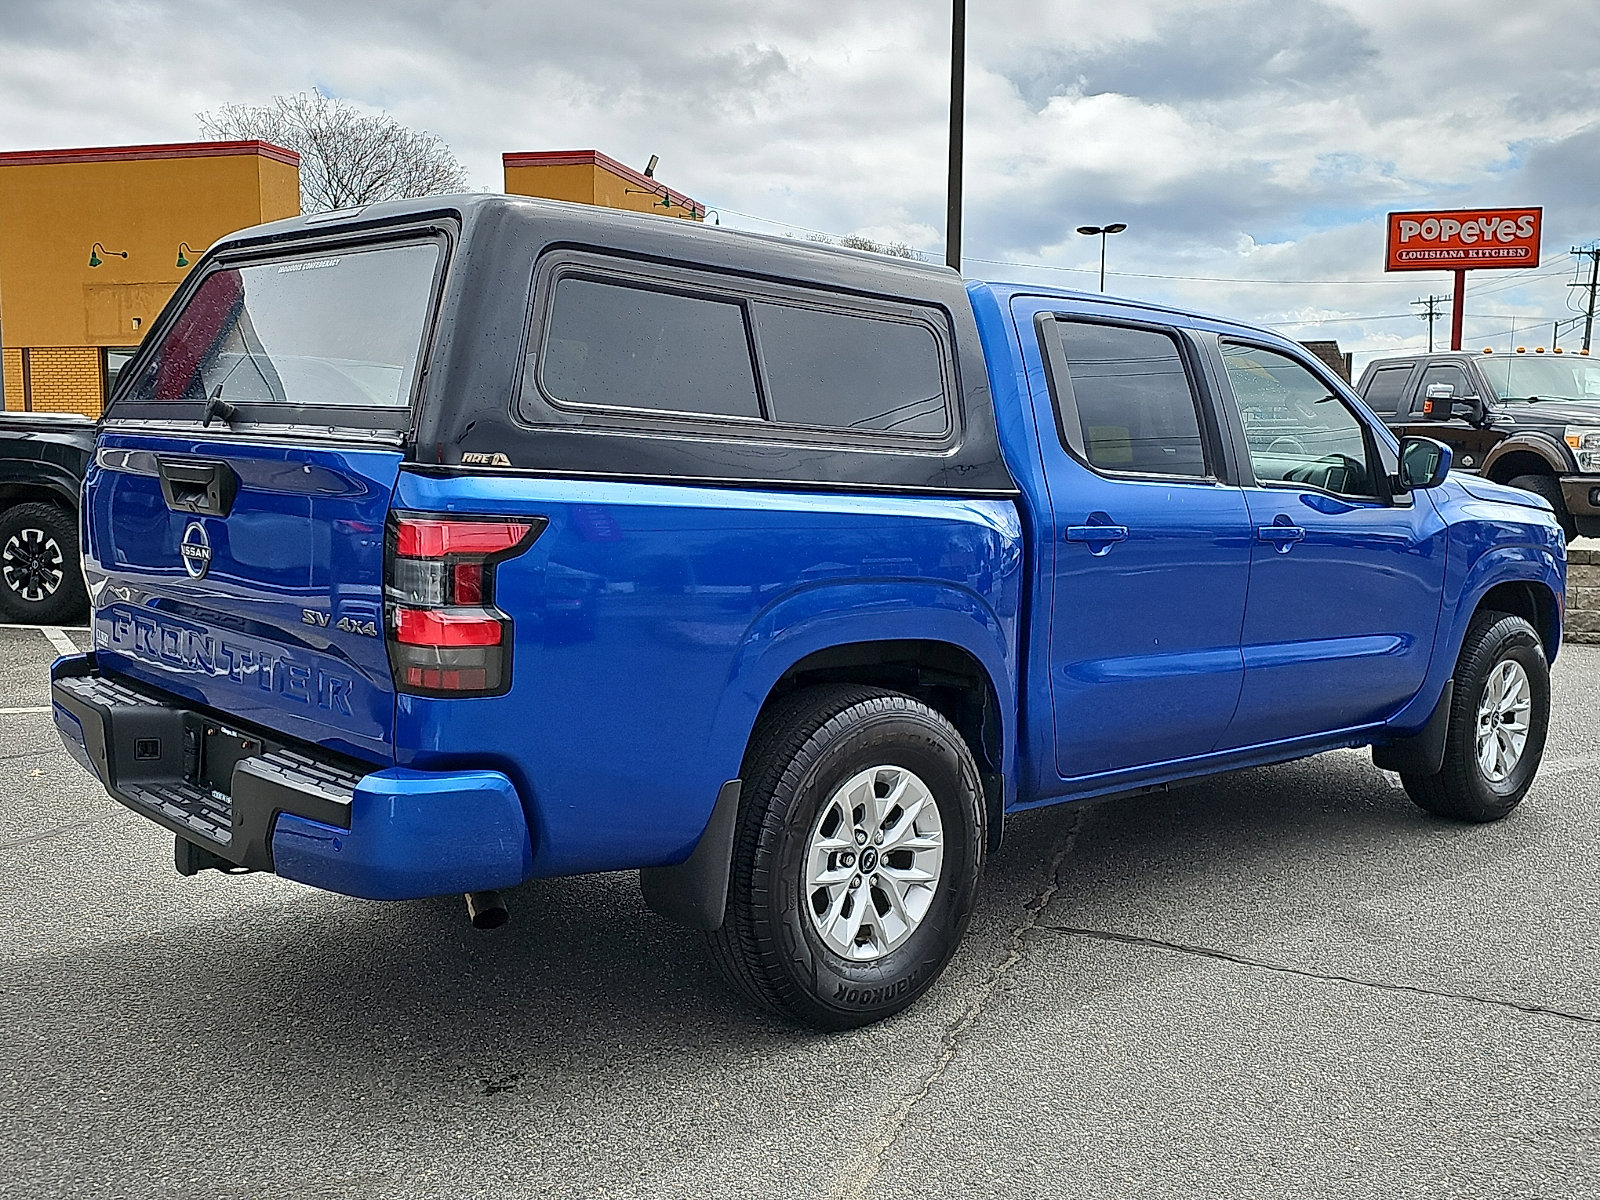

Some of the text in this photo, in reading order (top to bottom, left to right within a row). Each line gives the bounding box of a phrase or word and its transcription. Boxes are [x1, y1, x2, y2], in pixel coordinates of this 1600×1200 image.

[1401, 248, 1526, 260] LOUISIANA KITCHEN
[302, 608, 331, 627] SV
[112, 608, 354, 717] FRONTIER
